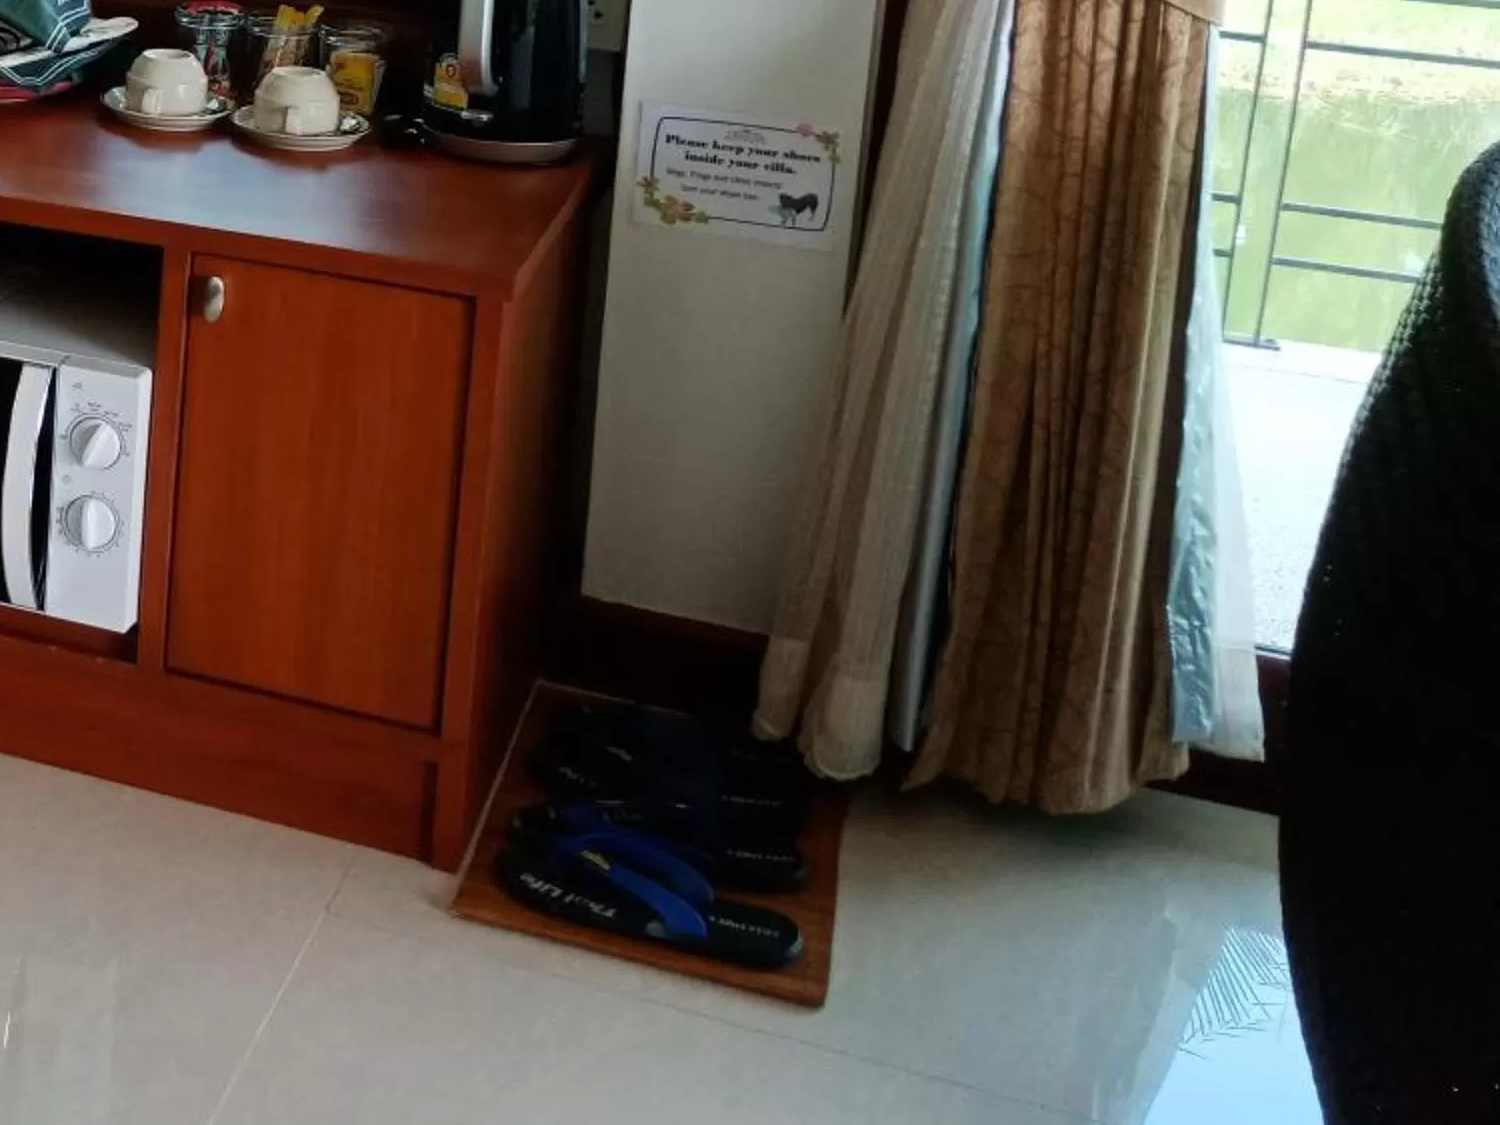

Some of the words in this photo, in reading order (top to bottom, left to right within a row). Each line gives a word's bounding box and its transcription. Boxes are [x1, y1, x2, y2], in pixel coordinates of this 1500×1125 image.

[665, 134, 708, 148] Please
[712, 139, 745, 155] keep
[747, 146, 779, 158] your
[782, 149, 821, 163] shoes
[685, 150, 724, 165] inside
[728, 159, 760, 169] your
